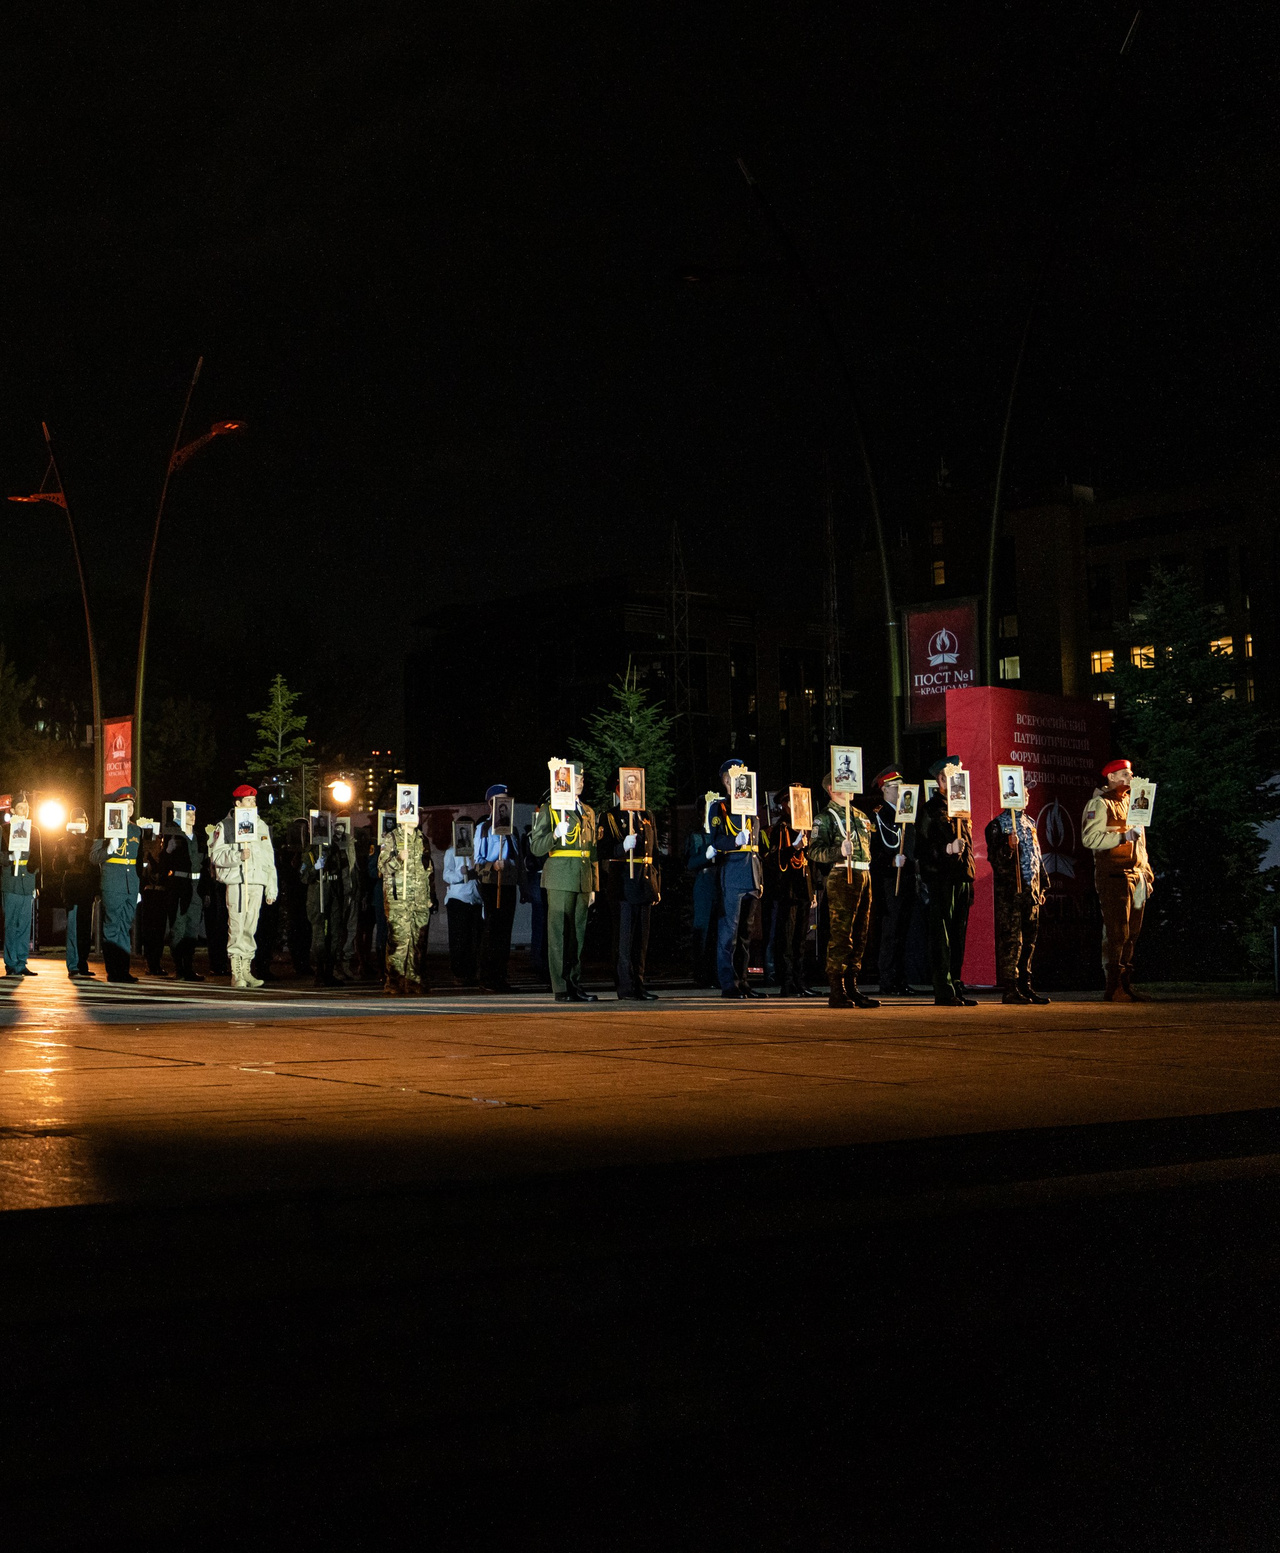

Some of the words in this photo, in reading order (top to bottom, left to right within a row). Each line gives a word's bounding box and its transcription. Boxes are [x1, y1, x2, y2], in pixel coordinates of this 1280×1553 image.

[914, 671, 952, 687] ПОСТ
[954, 669, 974, 682] №1
[1016, 713, 1087, 732] ВСЕРОССИЙСКИЙ
[1014, 732, 1090, 751] ПАТРИОТИЧЕСКИЙ
[1010, 750, 1040, 764] ФОРУМ
